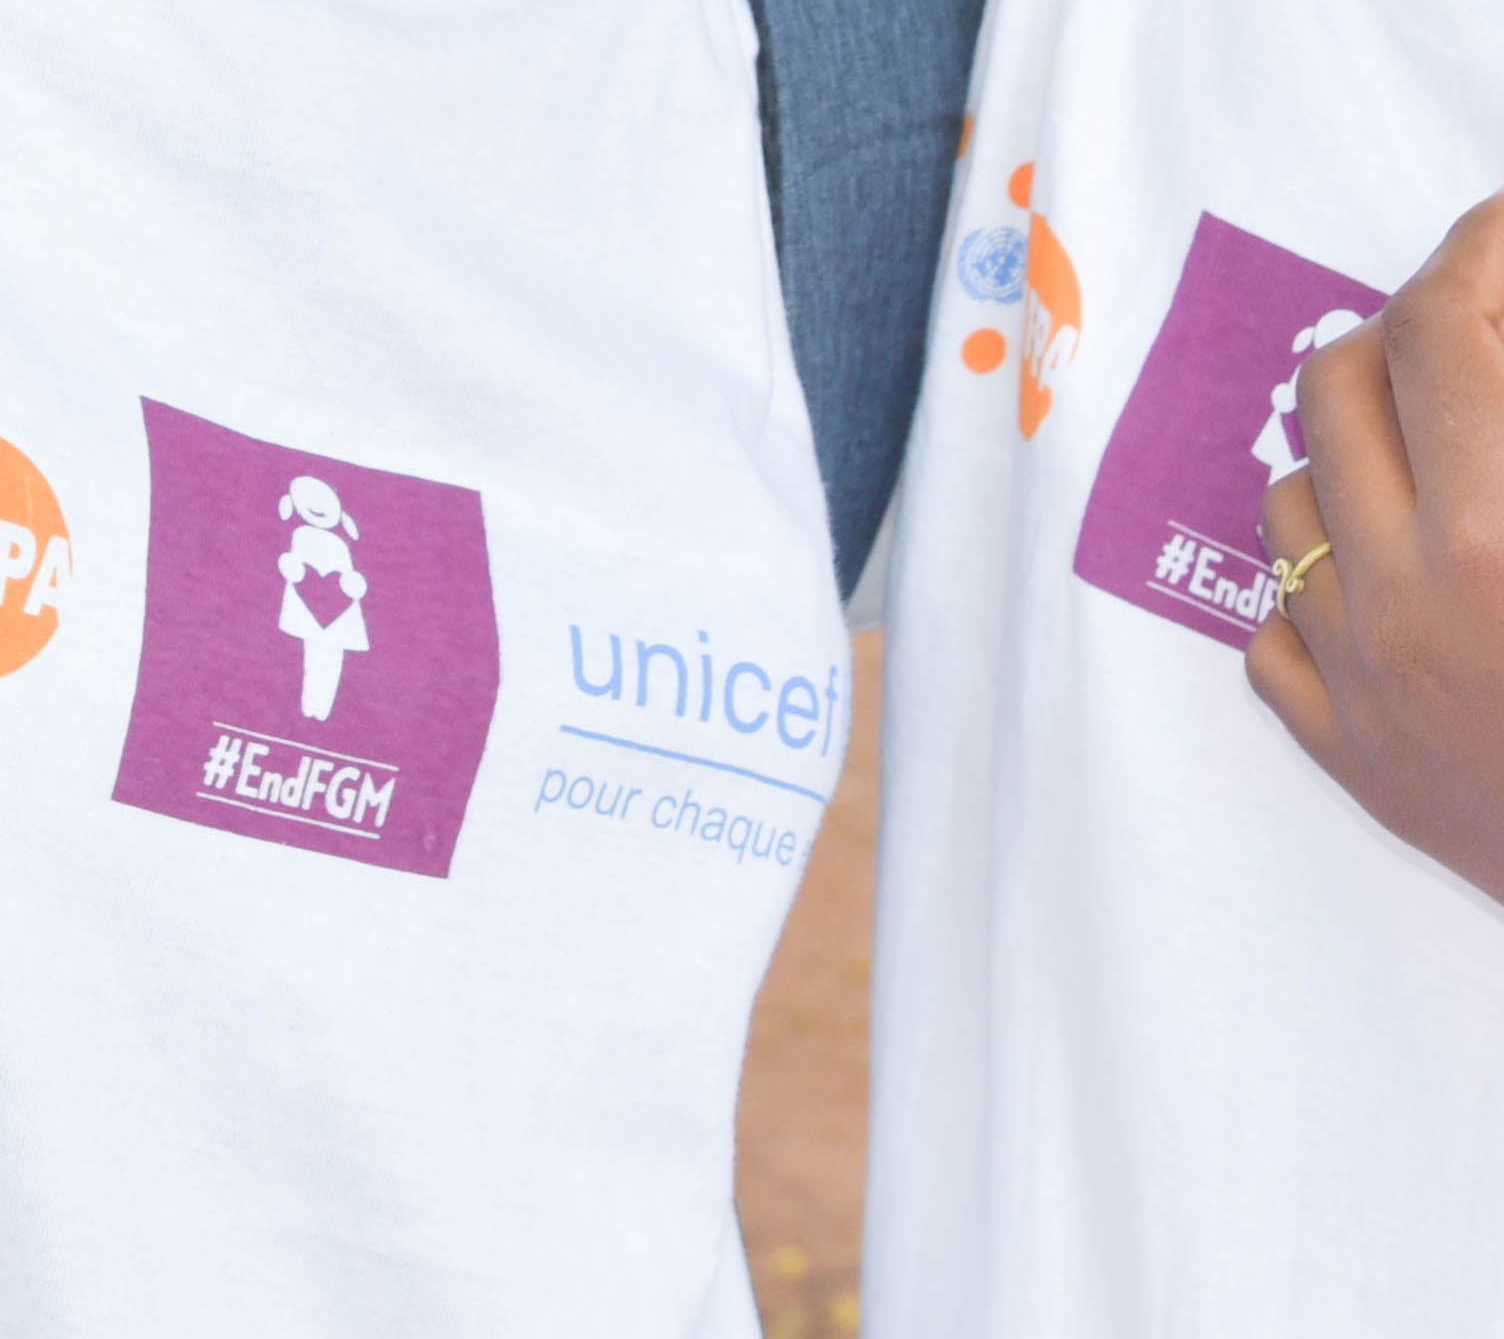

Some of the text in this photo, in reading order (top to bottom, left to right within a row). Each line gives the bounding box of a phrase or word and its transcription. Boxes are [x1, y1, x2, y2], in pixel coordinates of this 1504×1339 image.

[202, 734, 397, 828] #EndFGM
[533, 767, 798, 867] pour chaque
